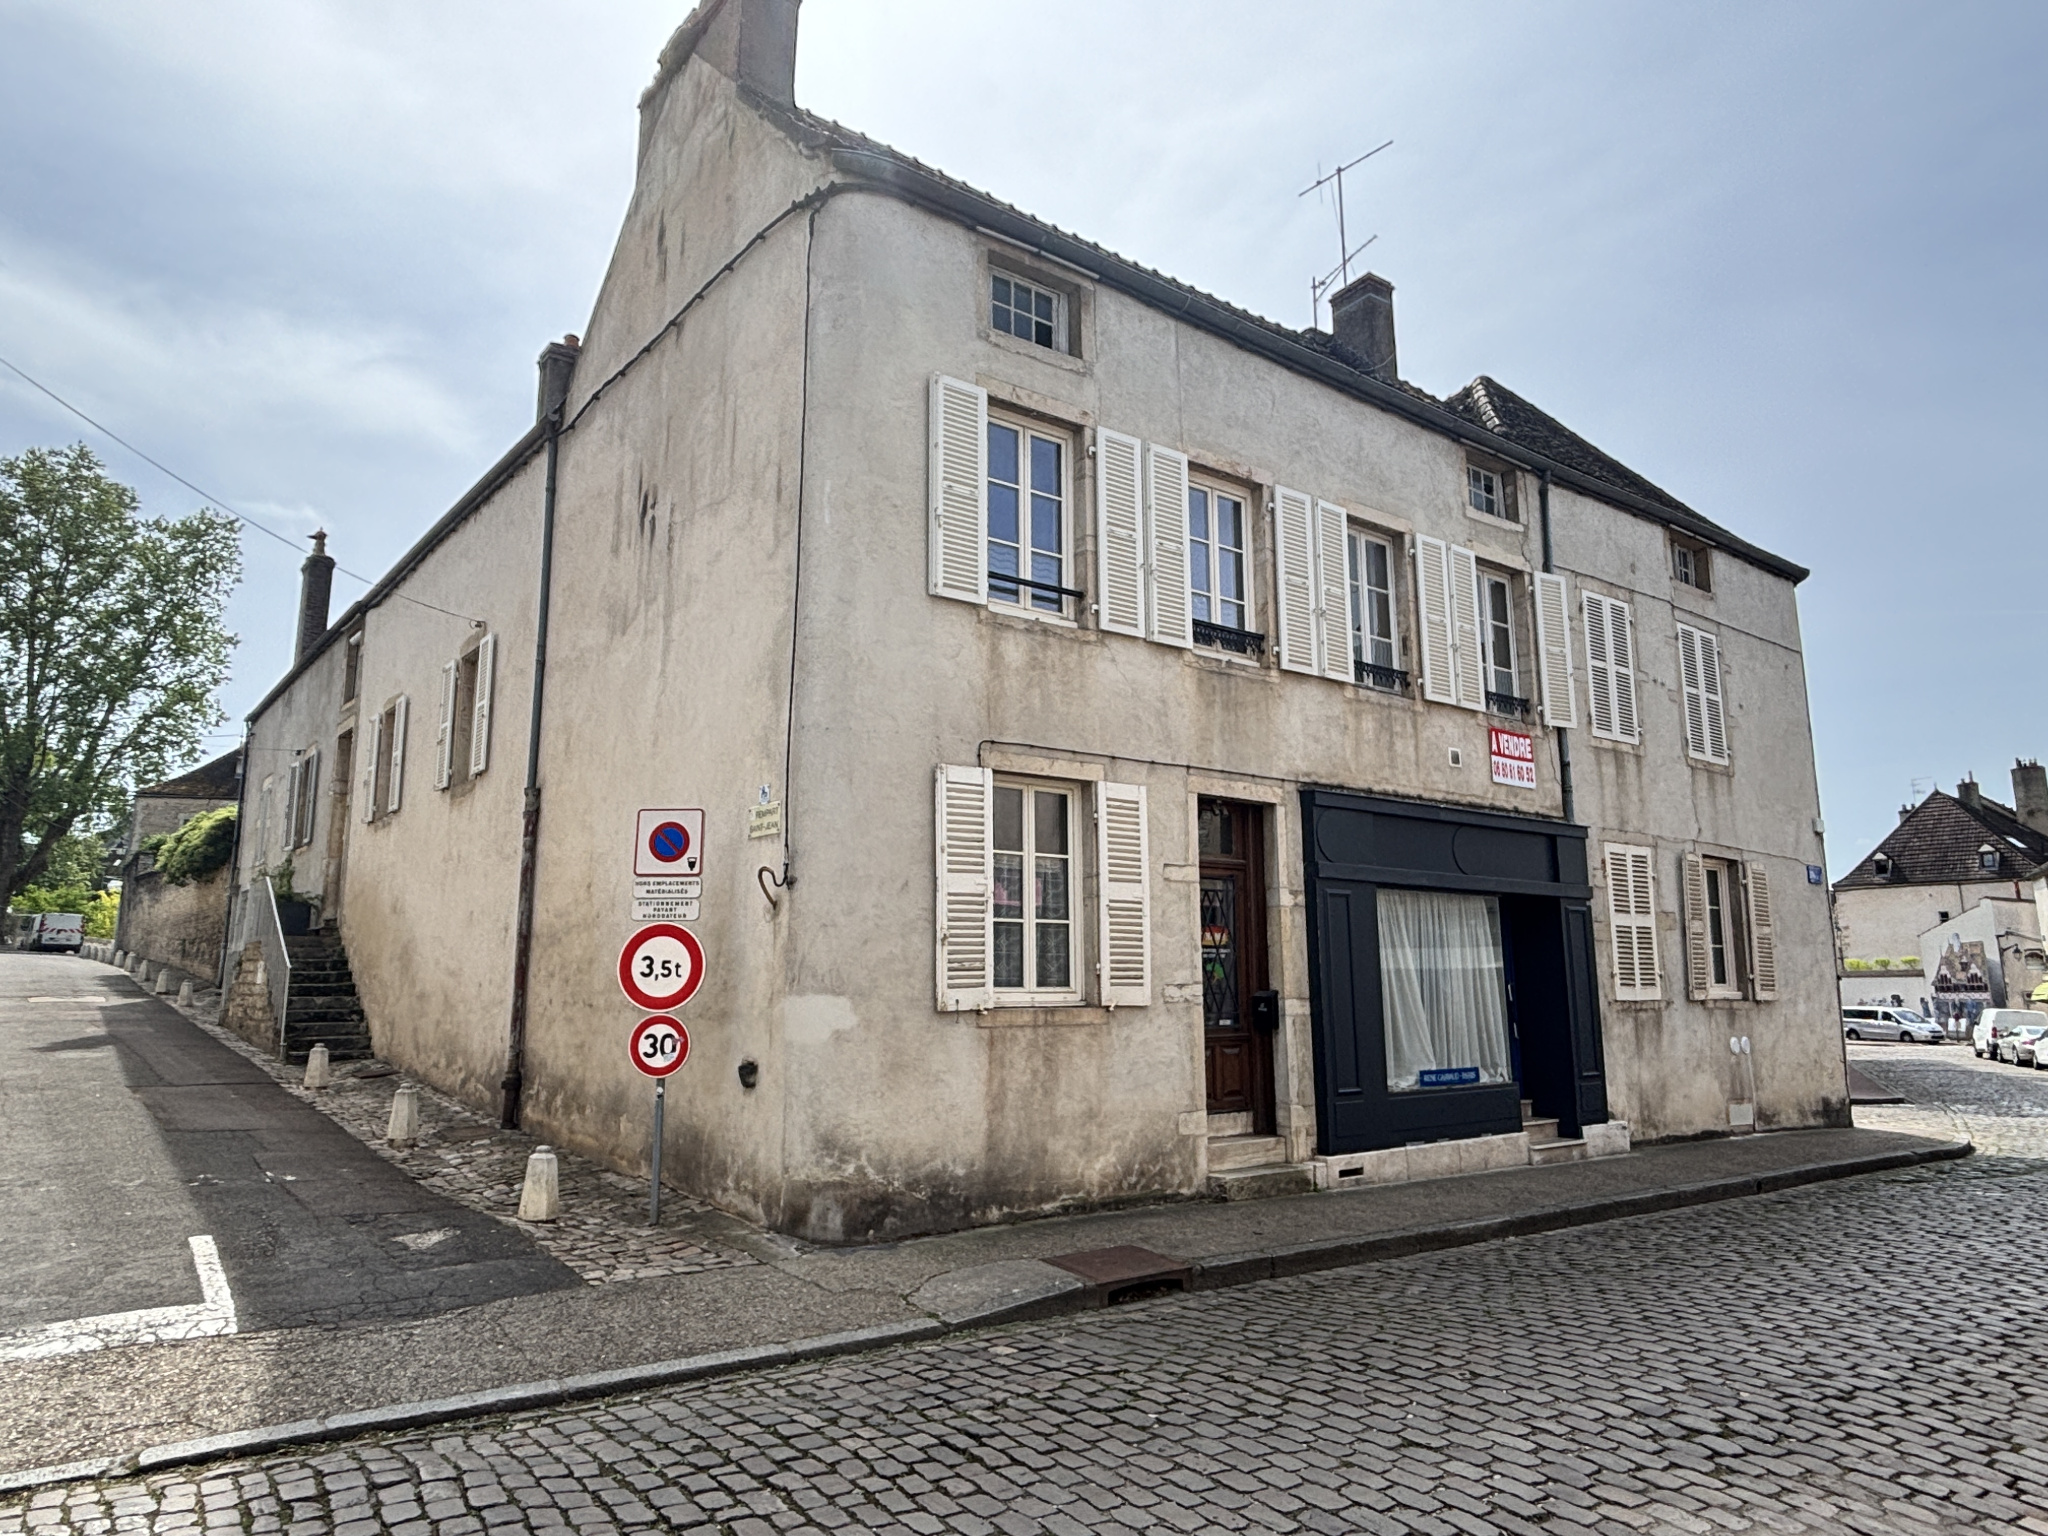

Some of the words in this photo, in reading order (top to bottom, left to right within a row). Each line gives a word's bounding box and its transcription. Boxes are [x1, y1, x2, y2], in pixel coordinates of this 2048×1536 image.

[1498, 732, 1533, 760] VENDRE
[750, 821, 779, 833] SAINT-JEAN
[643, 1033, 677, 1059] 30
